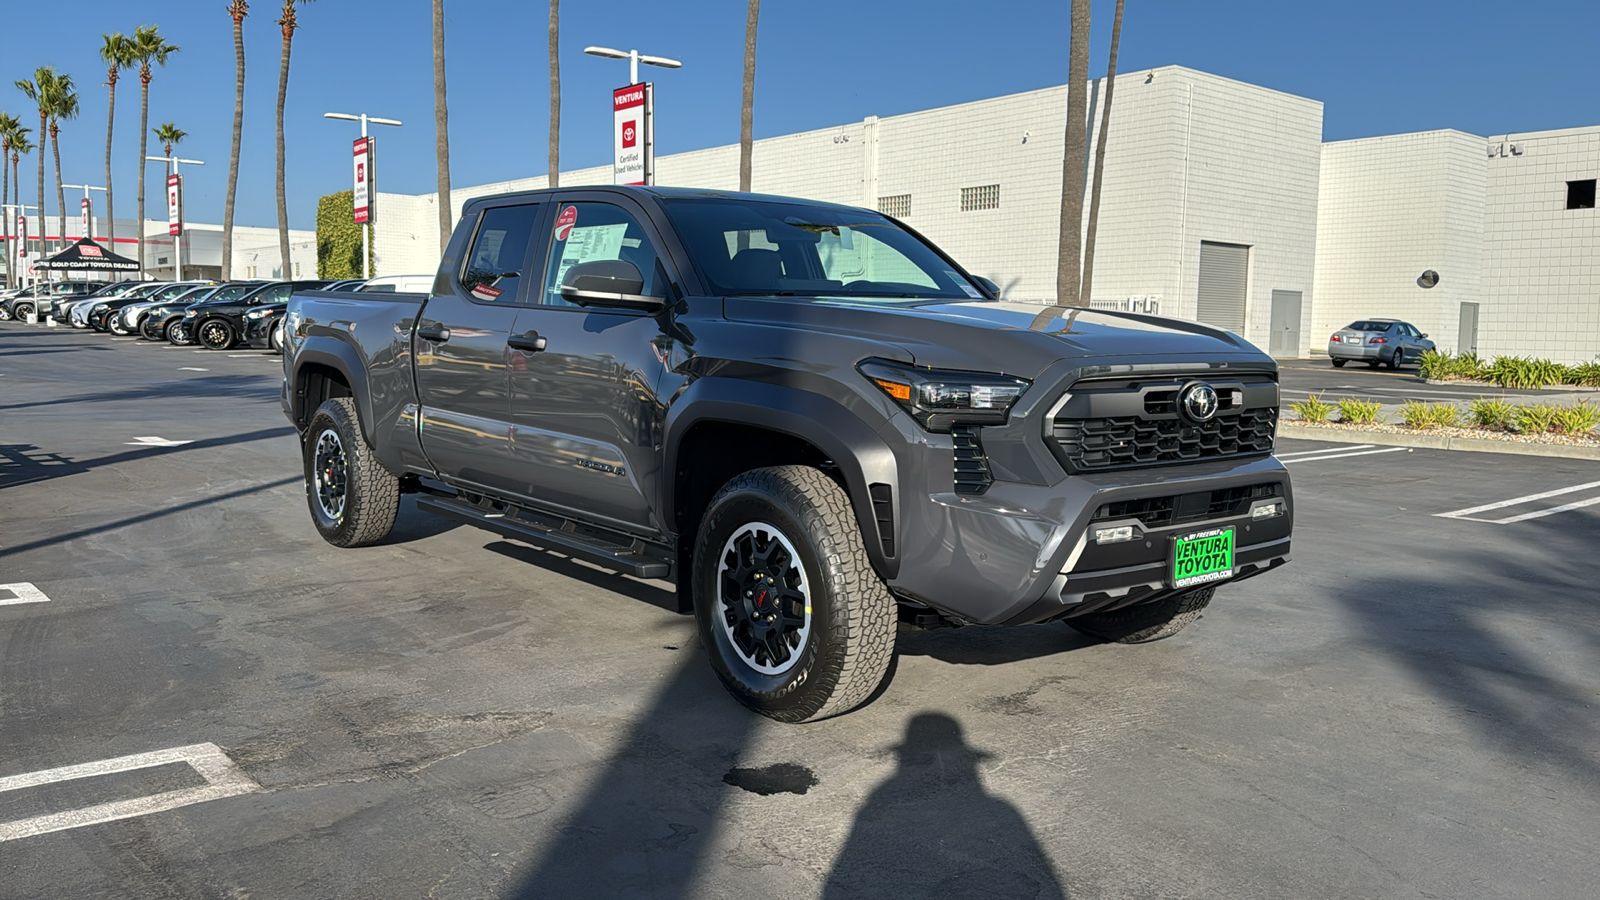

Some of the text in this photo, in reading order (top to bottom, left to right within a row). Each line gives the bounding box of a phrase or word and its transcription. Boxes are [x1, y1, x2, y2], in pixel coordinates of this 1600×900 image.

[615, 91, 643, 105] VENTURA
[620, 153, 638, 163] Certified
[1177, 537, 1229, 560] VENTURA
[1177, 552, 1227, 576] TOYOTA
[1176, 570, 1232, 587] VENTURATOYOTA.COM
